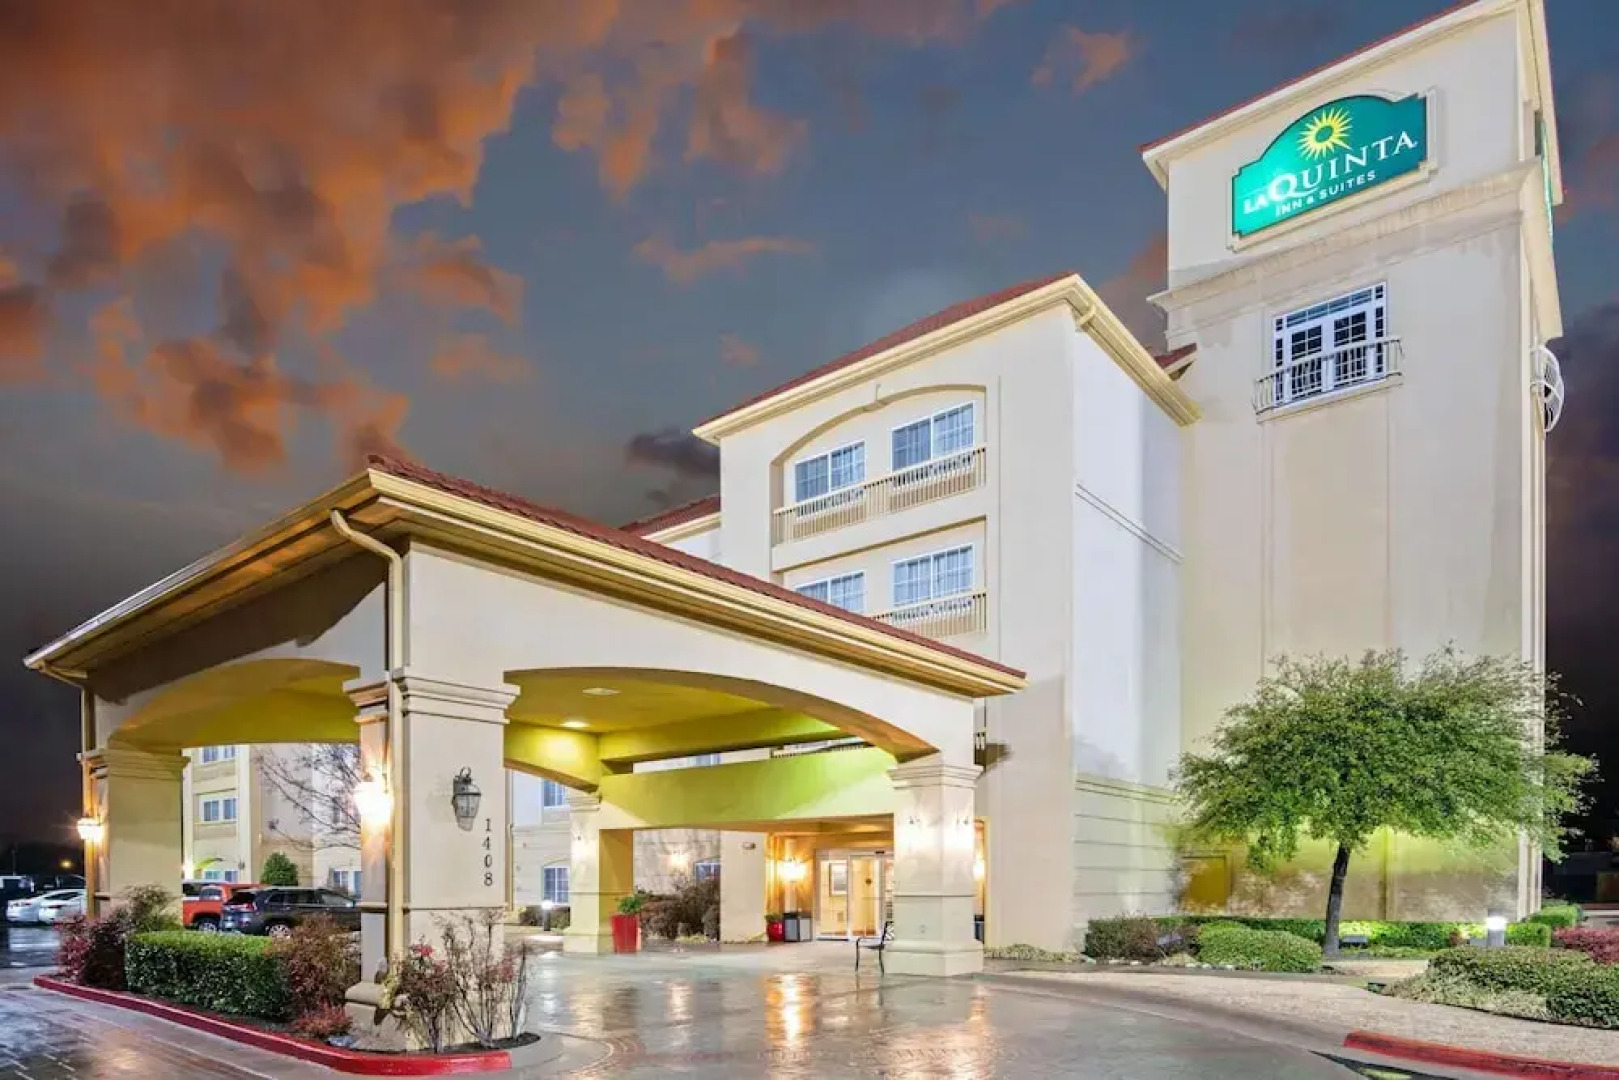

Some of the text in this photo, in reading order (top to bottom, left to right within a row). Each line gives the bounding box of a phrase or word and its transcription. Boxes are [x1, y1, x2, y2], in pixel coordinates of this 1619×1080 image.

[1243, 130, 1418, 215] LA QUINTA
[1276, 169, 1376, 218] INN & SUITES
[481, 818, 493, 886] 1408
